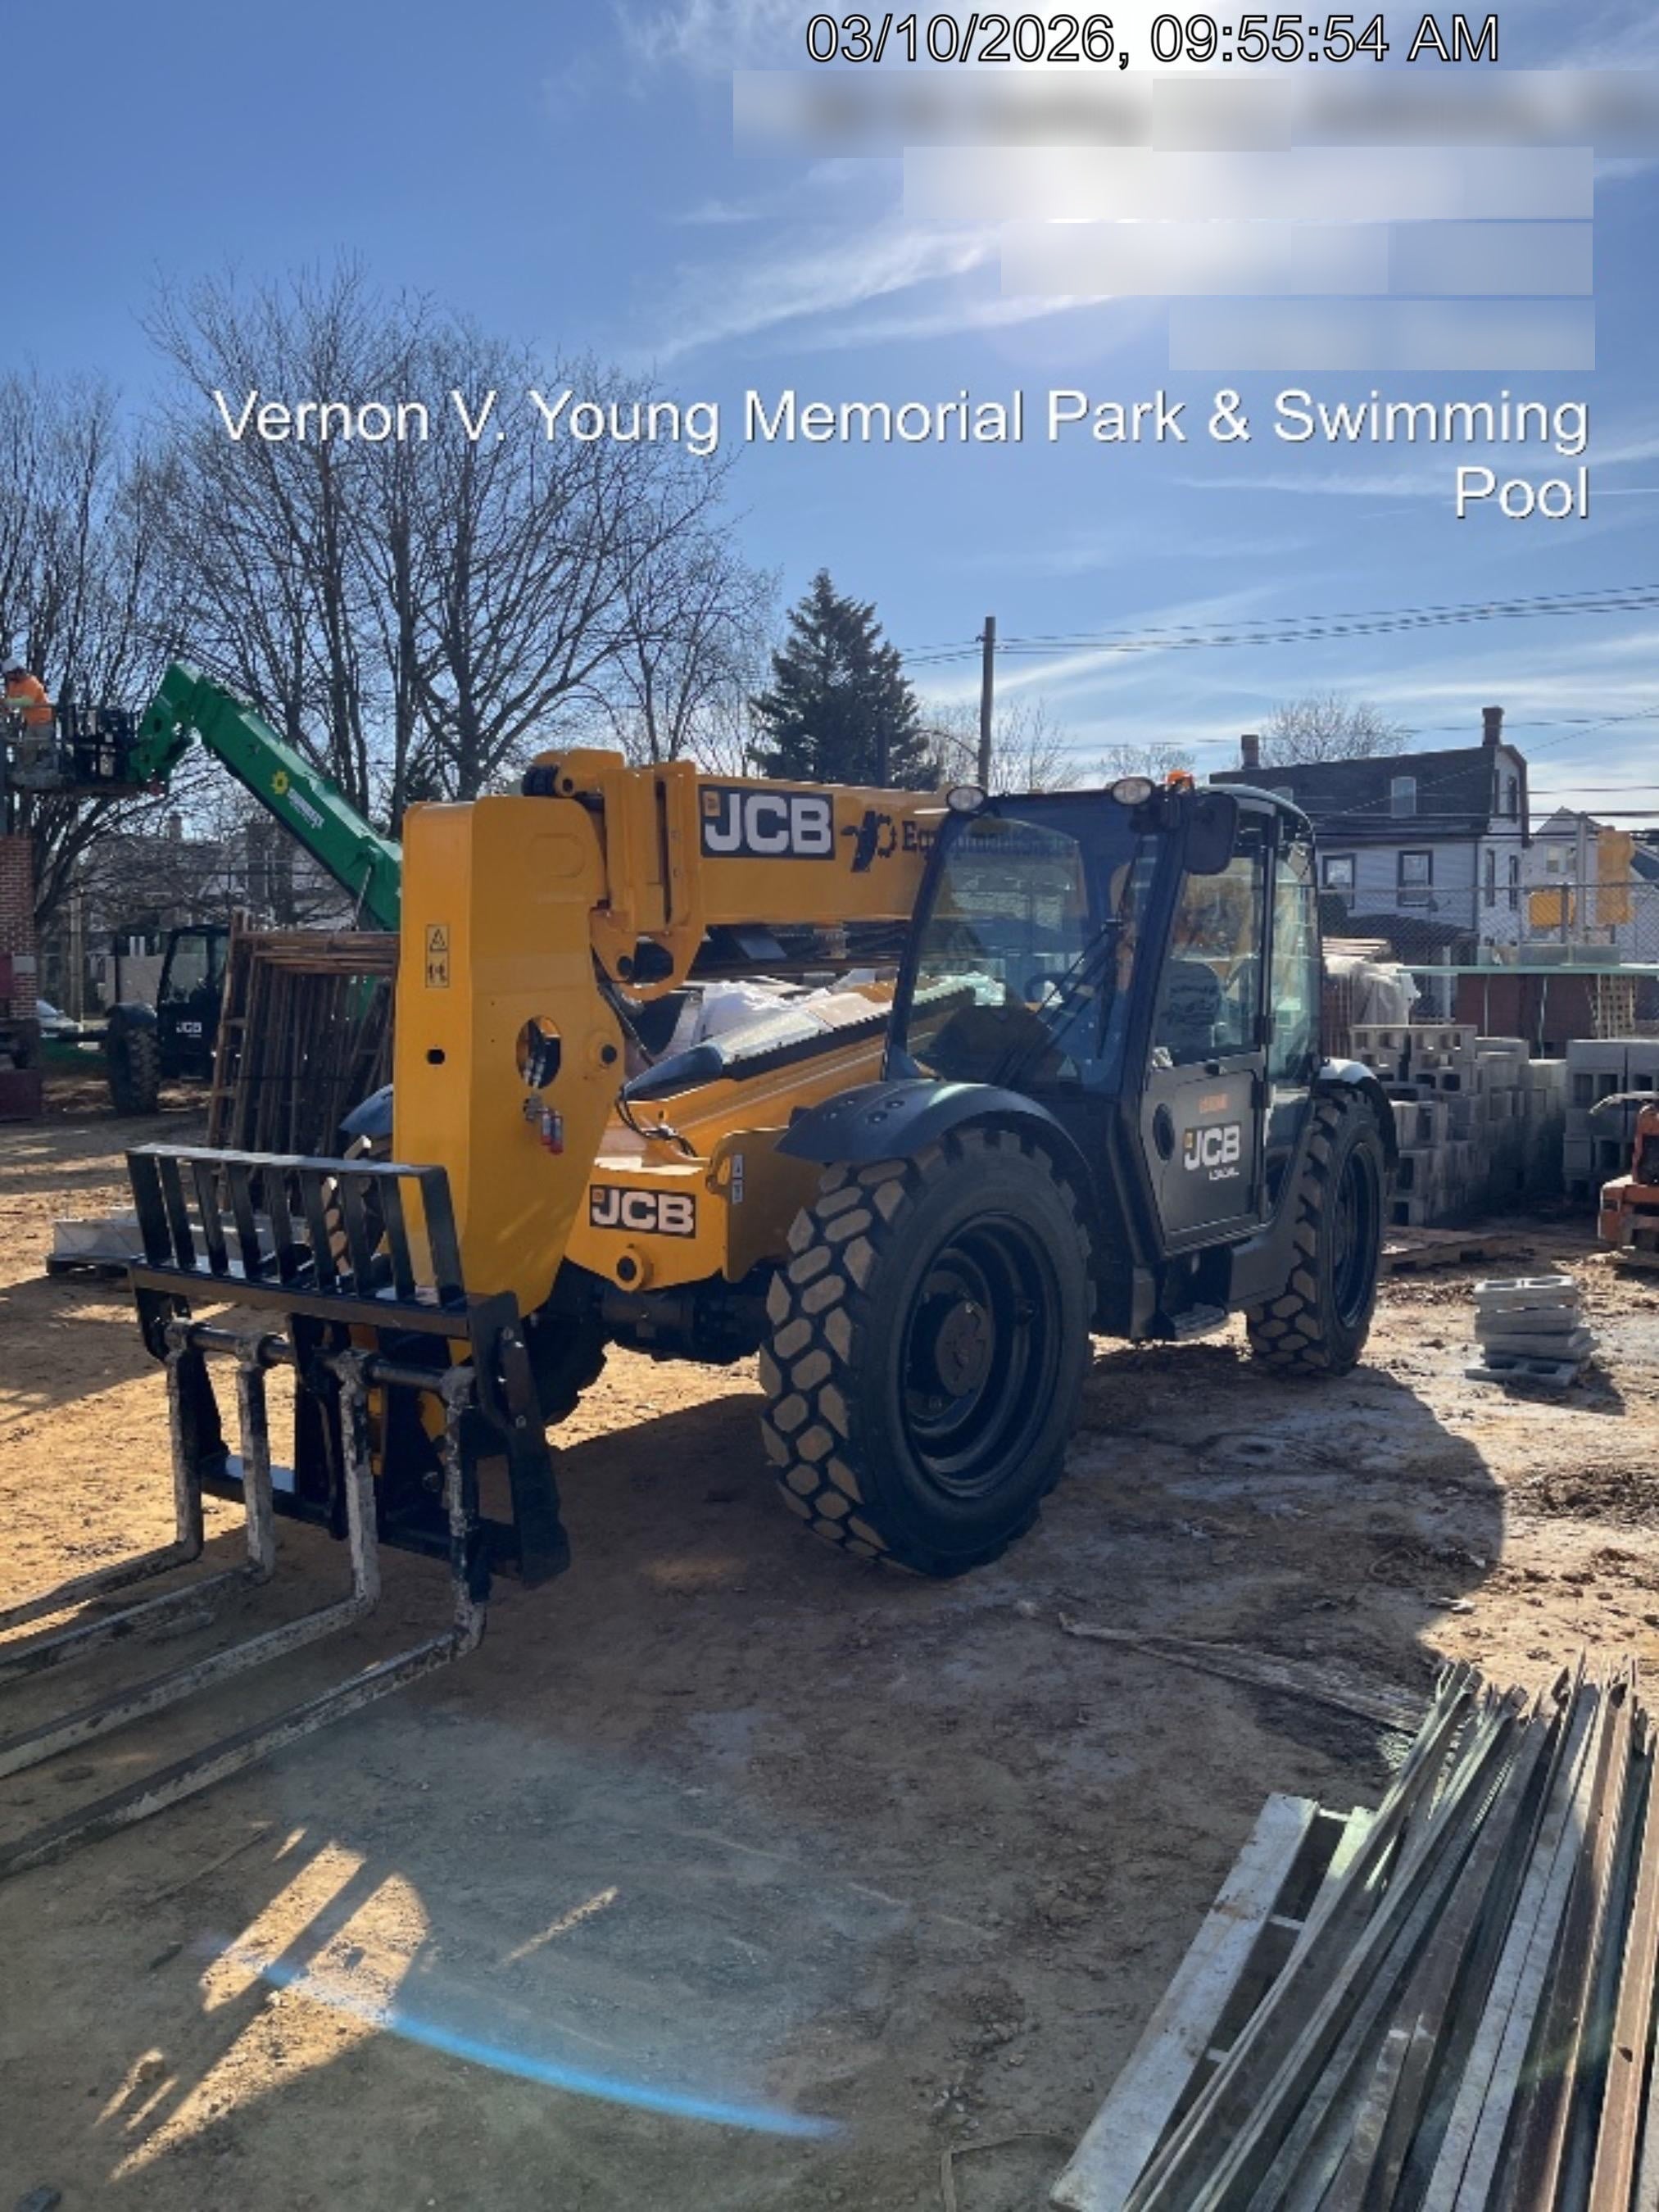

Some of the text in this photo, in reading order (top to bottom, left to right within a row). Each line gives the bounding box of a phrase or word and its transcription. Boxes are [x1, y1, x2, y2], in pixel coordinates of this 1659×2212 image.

[704, 792, 832, 854] JCB
[1183, 1124, 1240, 1172] JCB
[591, 1188, 695, 1235] JCB
